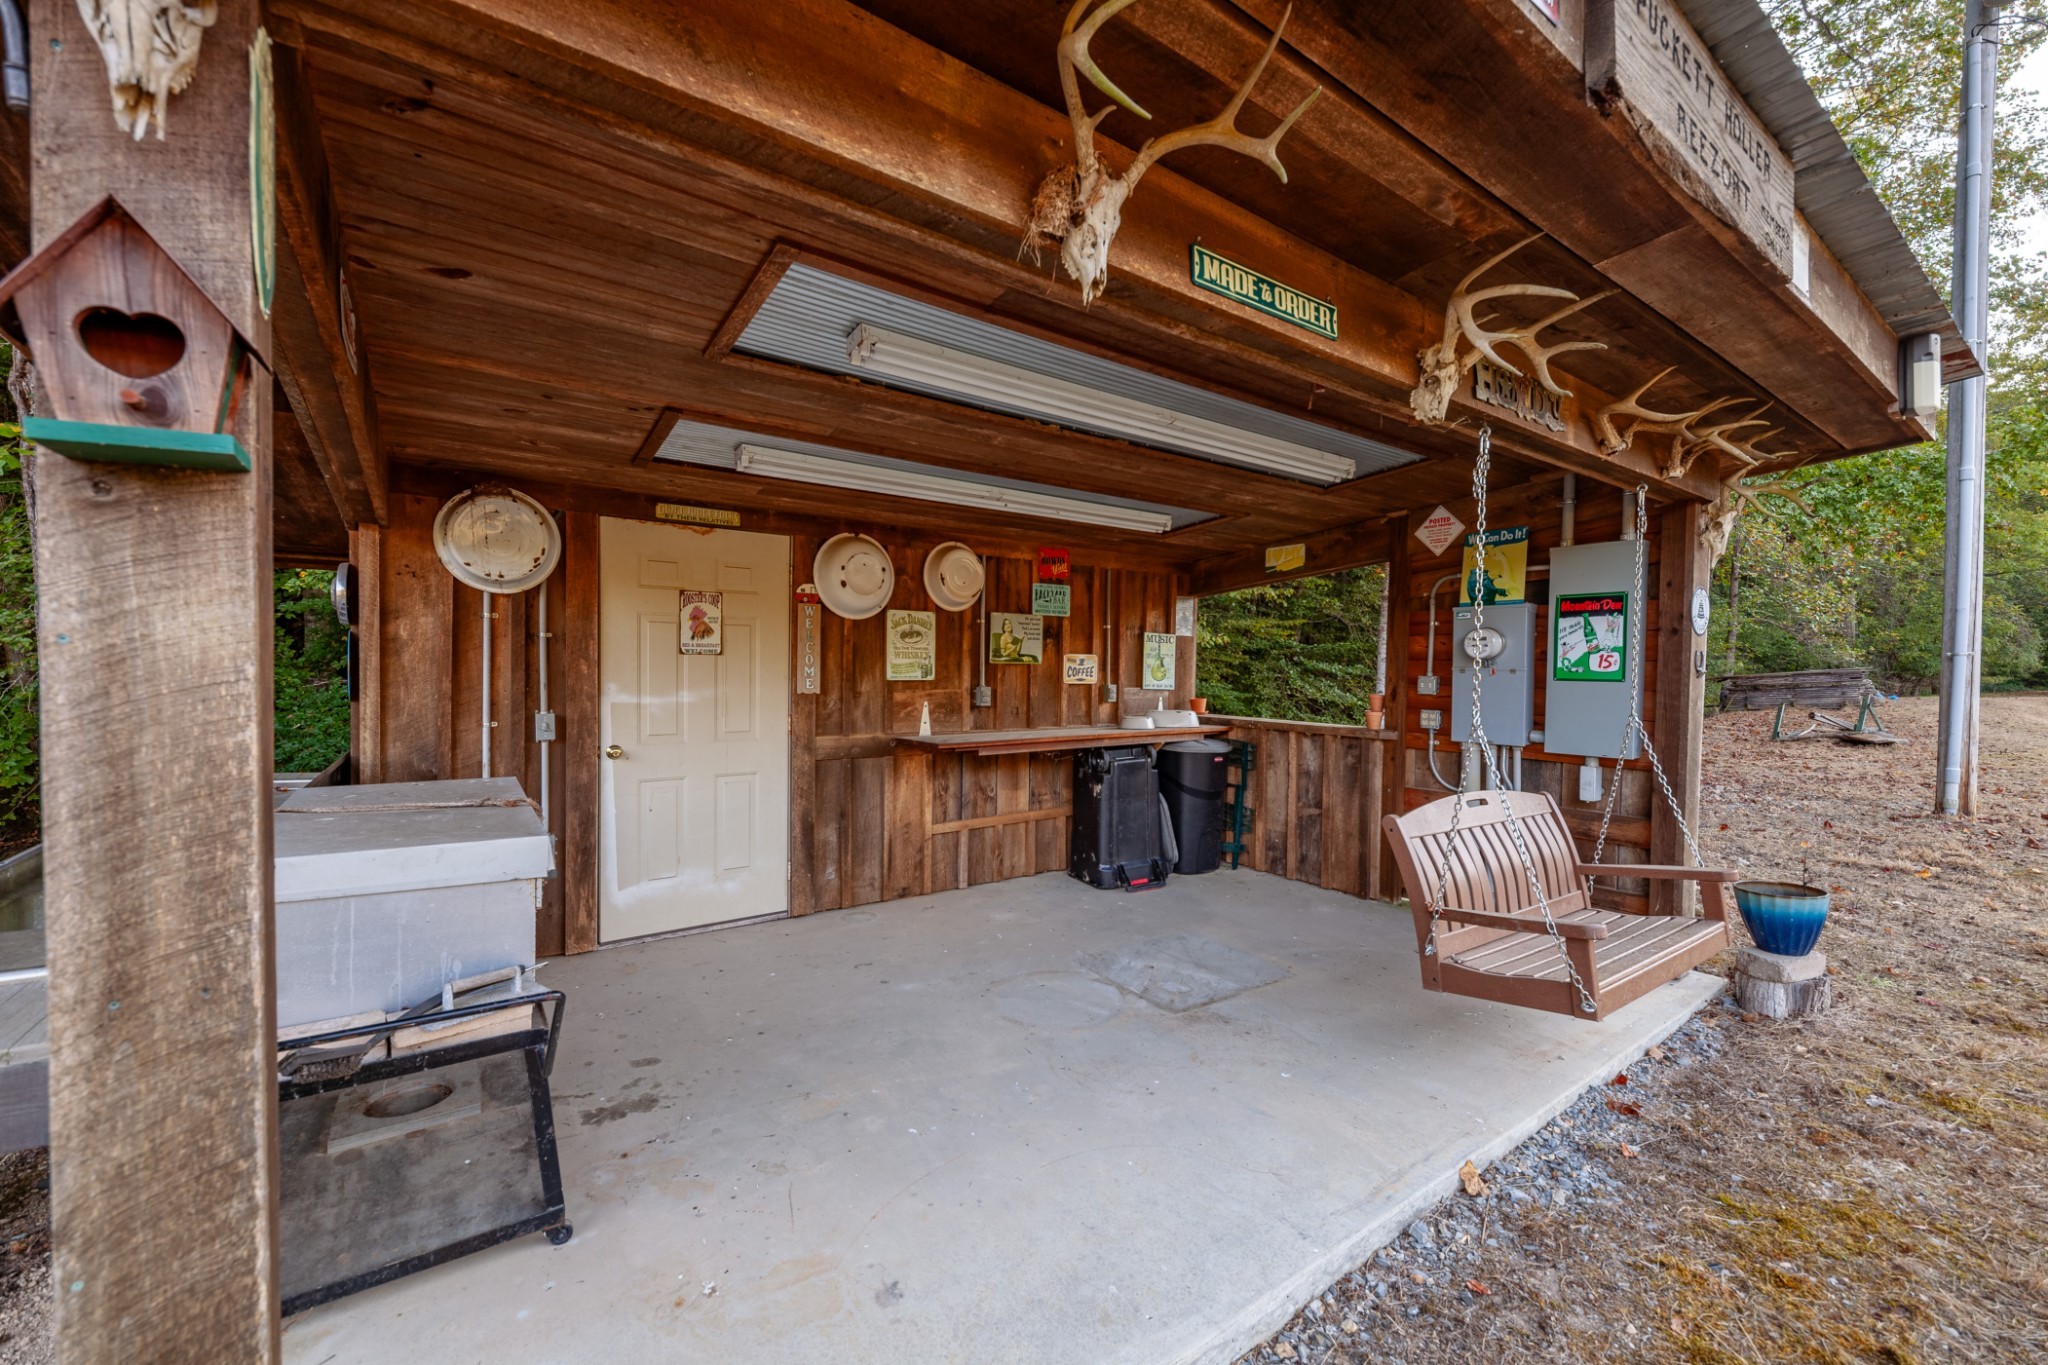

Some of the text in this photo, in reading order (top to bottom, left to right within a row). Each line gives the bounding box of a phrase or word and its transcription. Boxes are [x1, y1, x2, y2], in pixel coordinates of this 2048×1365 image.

[1724, 100, 1771, 183] HOLLER
[1677, 102, 1750, 213] REEZORT
[1202, 254, 1332, 333] MADE to ORDER
[1429, 516, 1451, 524] POSTED
[1500, 531, 1513, 541] Do
[1515, 528, 1527, 539] It!
[1561, 599, 1623, 611] Mountain Dew
[891, 615, 908, 630] JACK
[1145, 634, 1175, 644] MUSIC
[804, 605, 816, 689] WELCOME
[894, 651, 929, 660] WHISKEY
[1067, 665, 1095, 678] COFFEE
